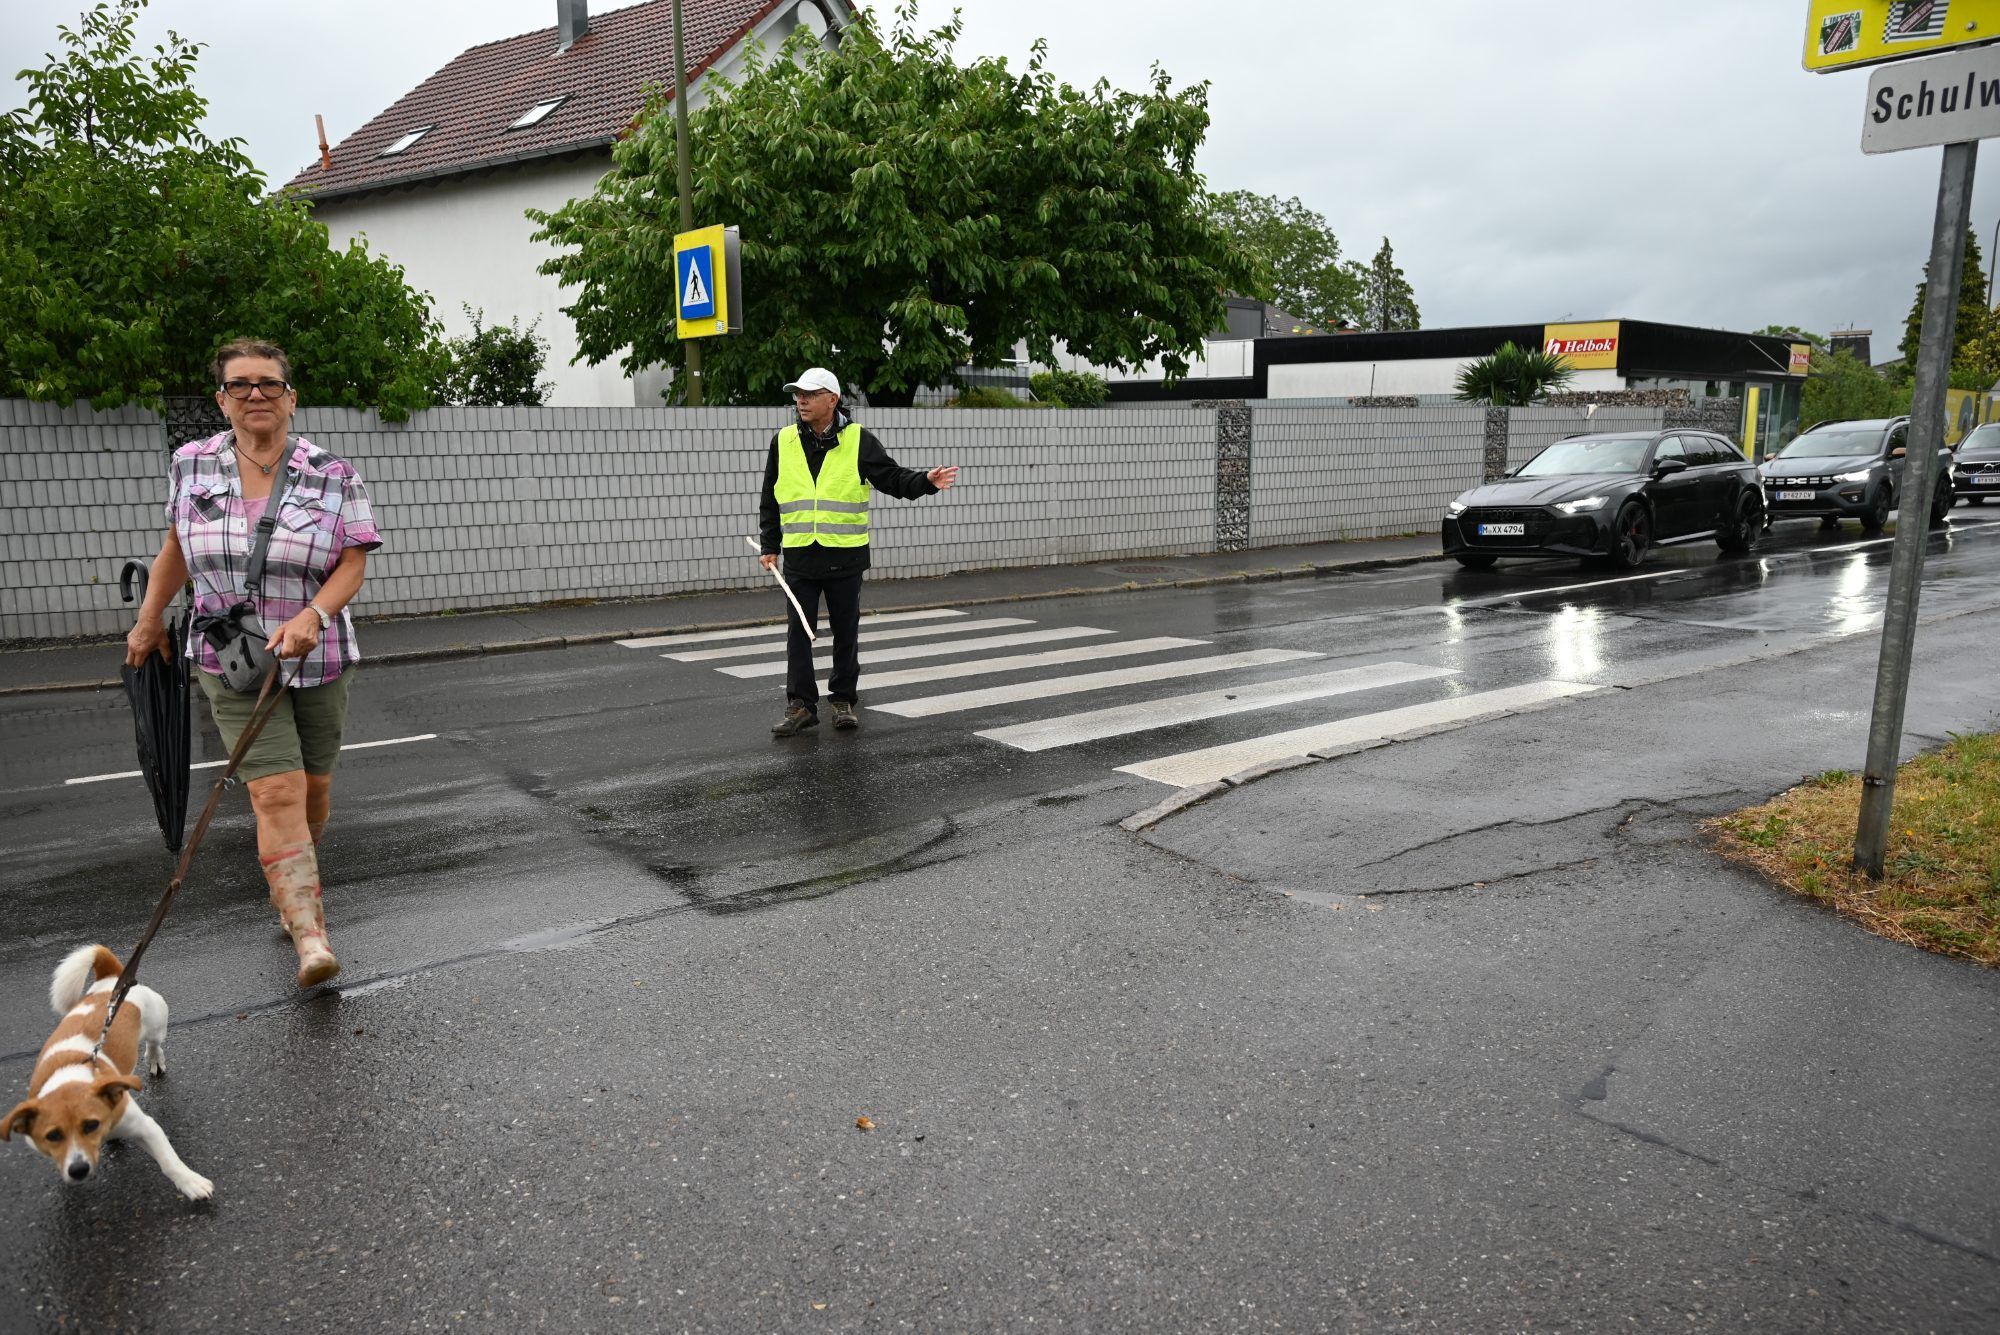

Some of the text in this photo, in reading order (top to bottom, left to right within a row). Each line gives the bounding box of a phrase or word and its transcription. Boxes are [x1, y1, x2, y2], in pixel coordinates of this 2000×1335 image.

[1564, 339, 1612, 353] Helbok
[1482, 525, 1523, 534] M XX 4794
